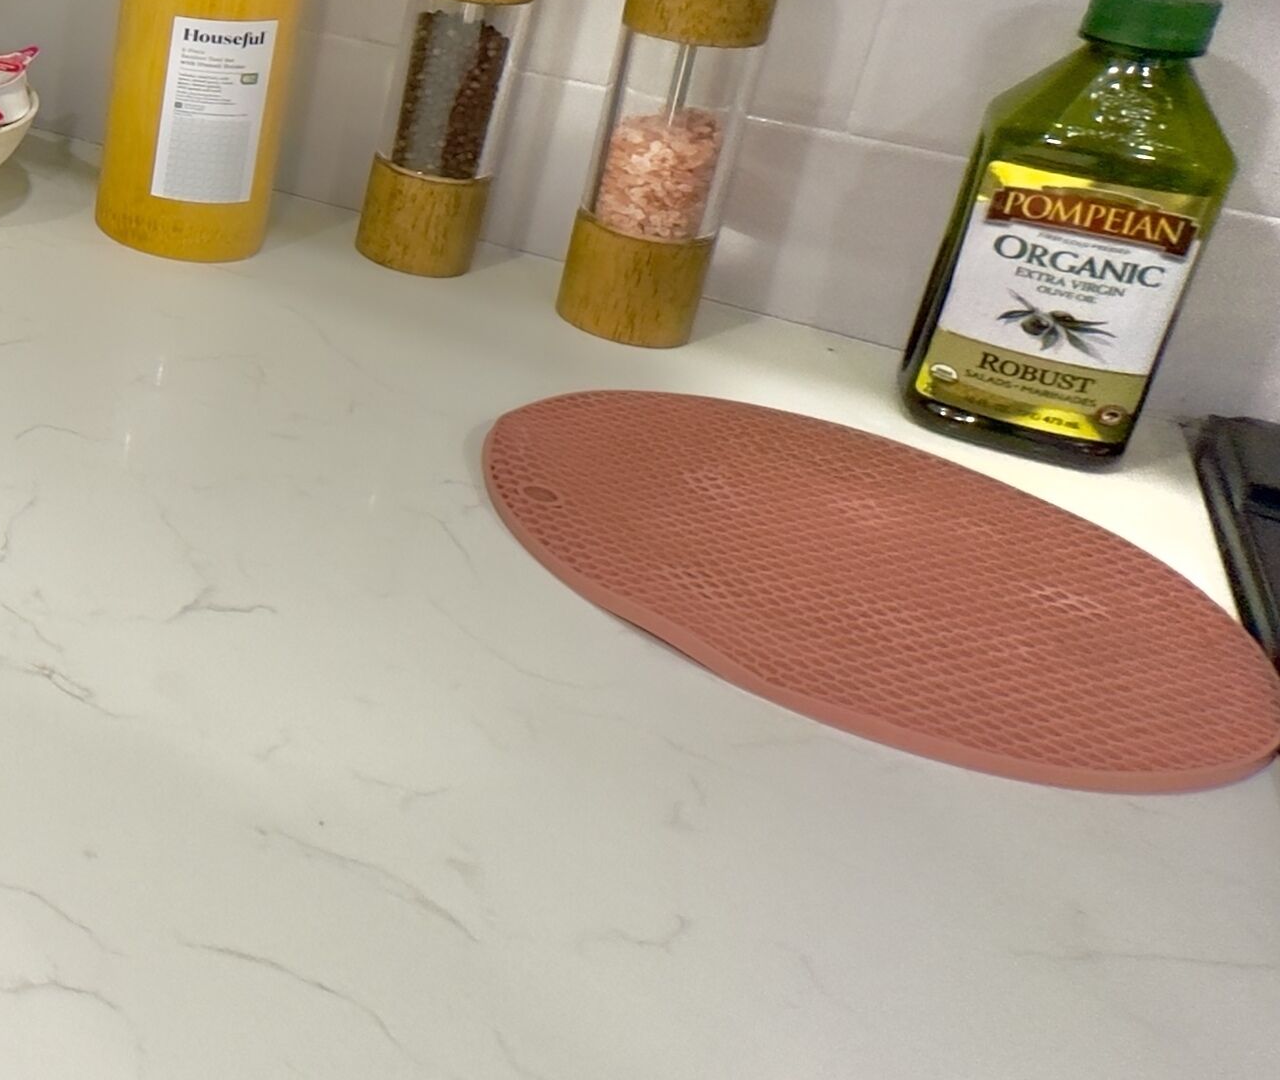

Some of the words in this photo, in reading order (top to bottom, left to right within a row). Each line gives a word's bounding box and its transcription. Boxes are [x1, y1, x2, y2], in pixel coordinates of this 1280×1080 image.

[183, 28, 265, 49] Houseful
[1002, 191, 1185, 245] POMPEIAN
[993, 234, 1166, 288] ORGANIC
[1014, 266, 1066, 288] EXTRA
[1071, 279, 1127, 298] VIRGIN
[1036, 284, 1075, 301] OLIVE
[965, 368, 1012, 390] SALADS
[1020, 384, 1098, 408] MARINADES
[977, 351, 1097, 394] ROBUST
